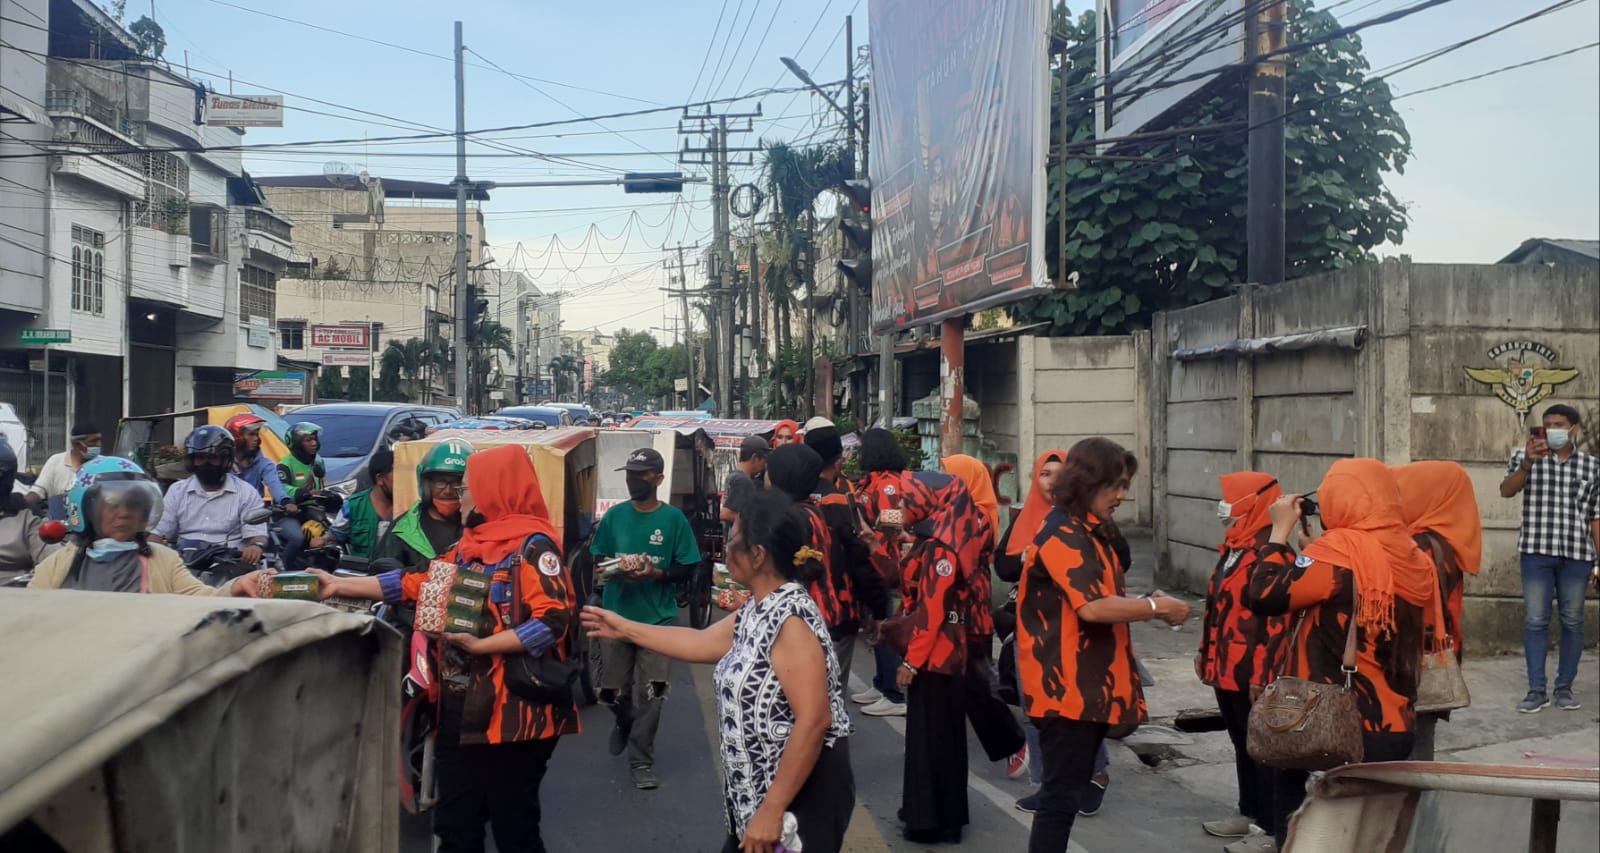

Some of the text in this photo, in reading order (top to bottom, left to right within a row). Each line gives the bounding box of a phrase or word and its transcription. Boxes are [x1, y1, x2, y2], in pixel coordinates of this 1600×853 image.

[925, 49, 957, 93] TAHUN
[318, 335, 361, 344] AC MOBIL
[1535, 344, 1557, 362] INTI
[443, 457, 466, 467] Grab
